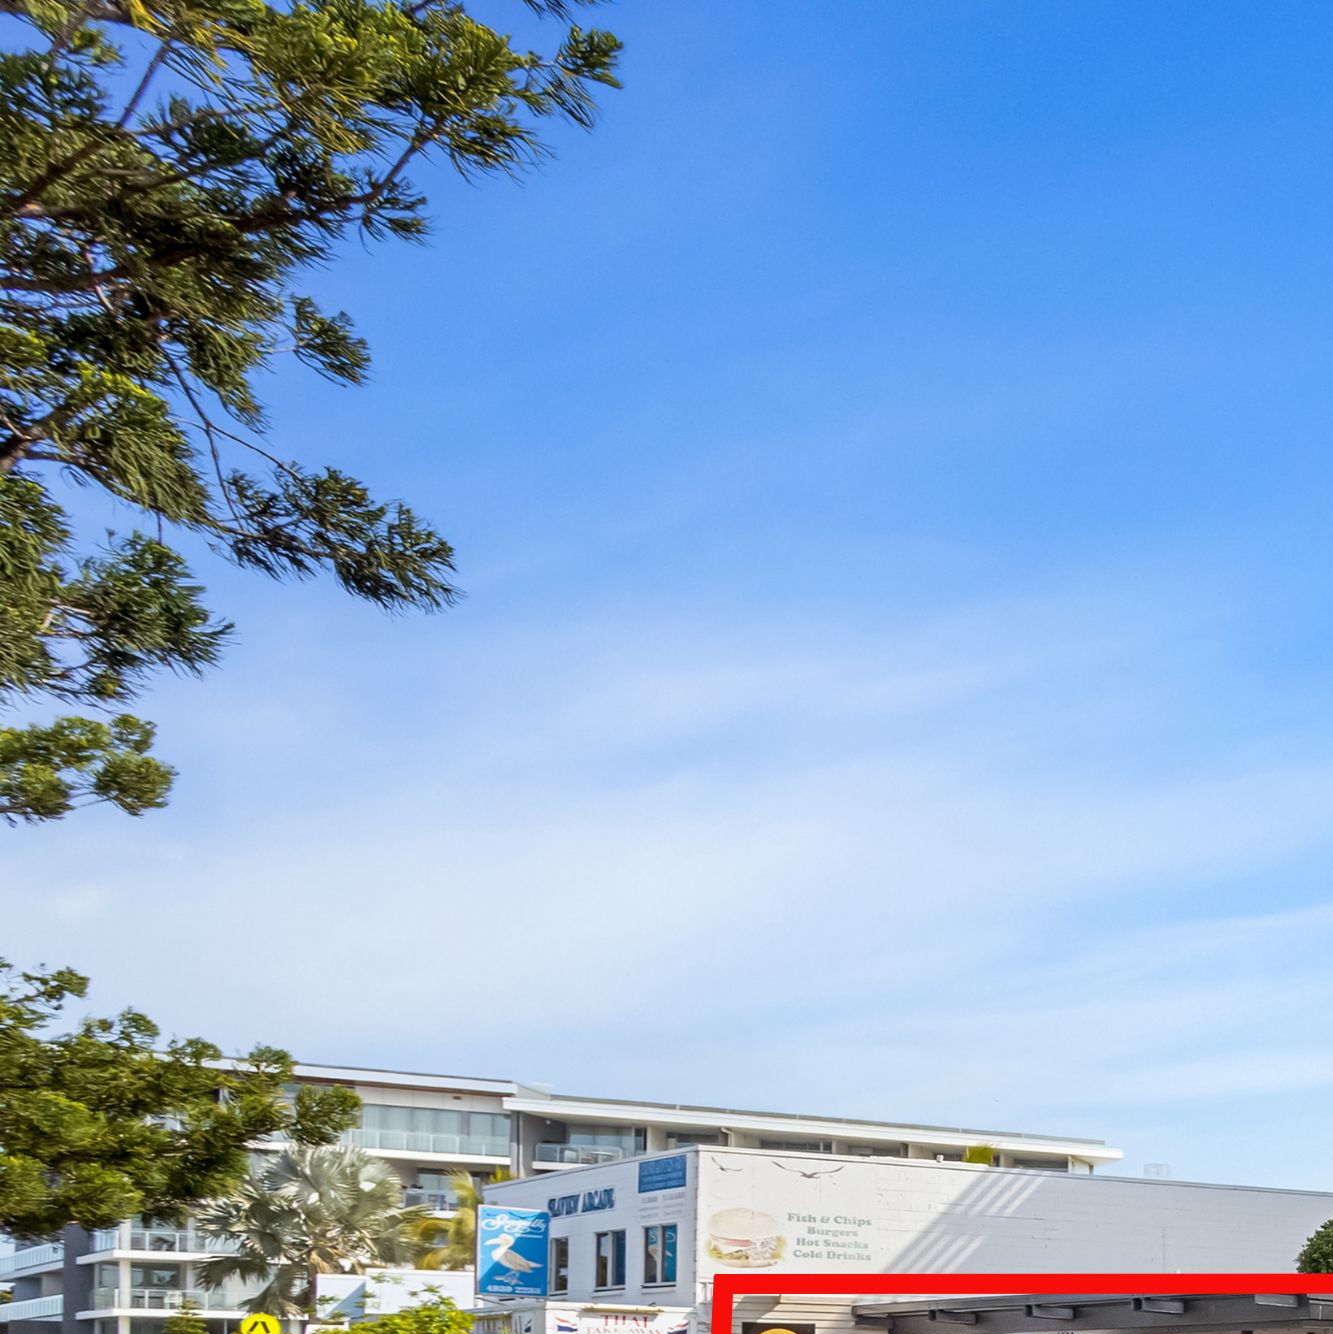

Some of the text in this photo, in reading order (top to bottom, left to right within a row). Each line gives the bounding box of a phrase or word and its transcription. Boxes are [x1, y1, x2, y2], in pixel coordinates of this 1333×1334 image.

[787, 1213, 817, 1223] Fish
[833, 1215, 872, 1227] Chips
[807, 1226, 858, 1238] Burgers
[796, 1238, 869, 1249] Hot Snacks
[793, 1250, 871, 1261] Cold Drinks
[600, 1314, 649, 1328] THAI
